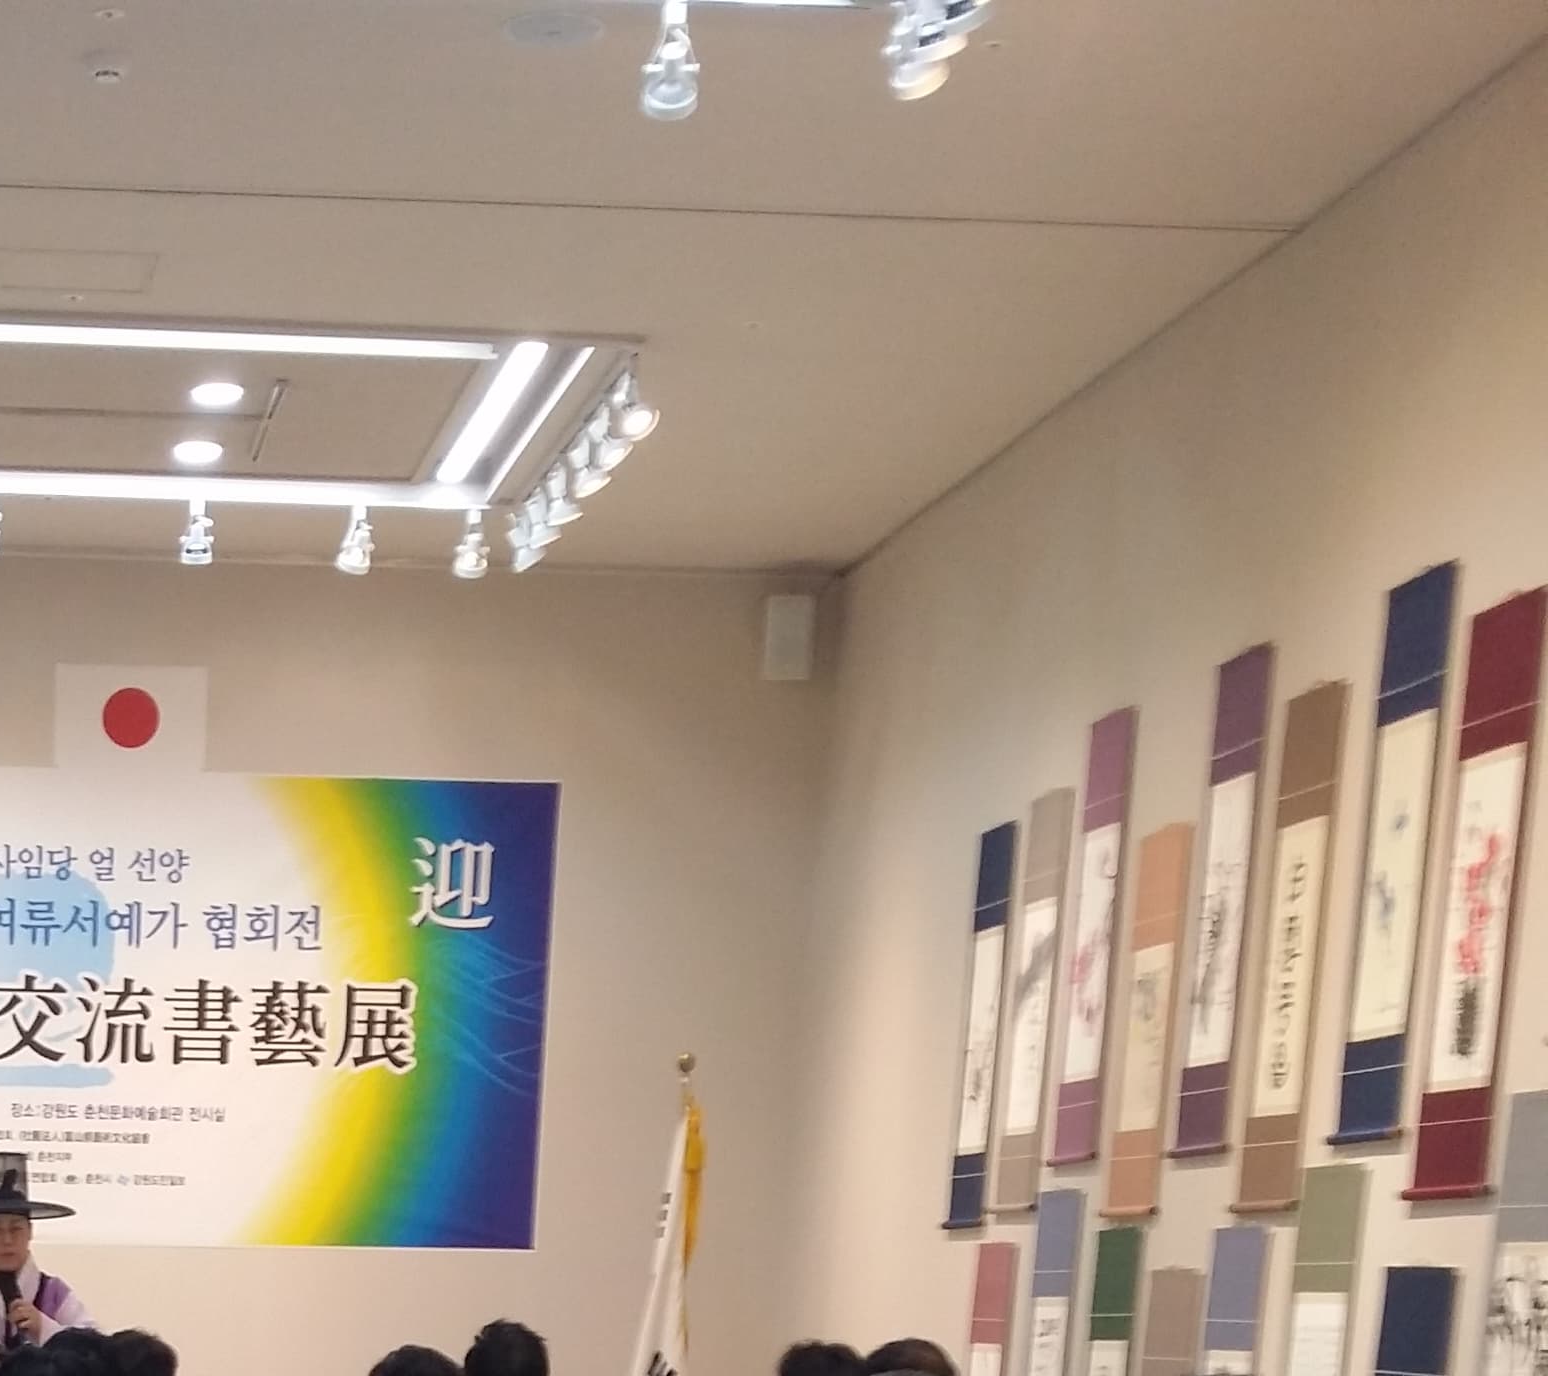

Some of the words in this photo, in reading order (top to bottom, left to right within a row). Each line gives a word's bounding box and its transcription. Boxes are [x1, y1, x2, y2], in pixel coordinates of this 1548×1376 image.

[88, 846, 116, 882] 얼
[127, 847, 191, 884] 선양
[408, 835, 495, 930] 迎
[201, 902, 323, 952] 협회전
[11, 1102, 79, 1119] 장소:강원도
[83, 1103, 184, 1121] 춘천문화예술회관
[189, 1106, 226, 1122] 전시실
